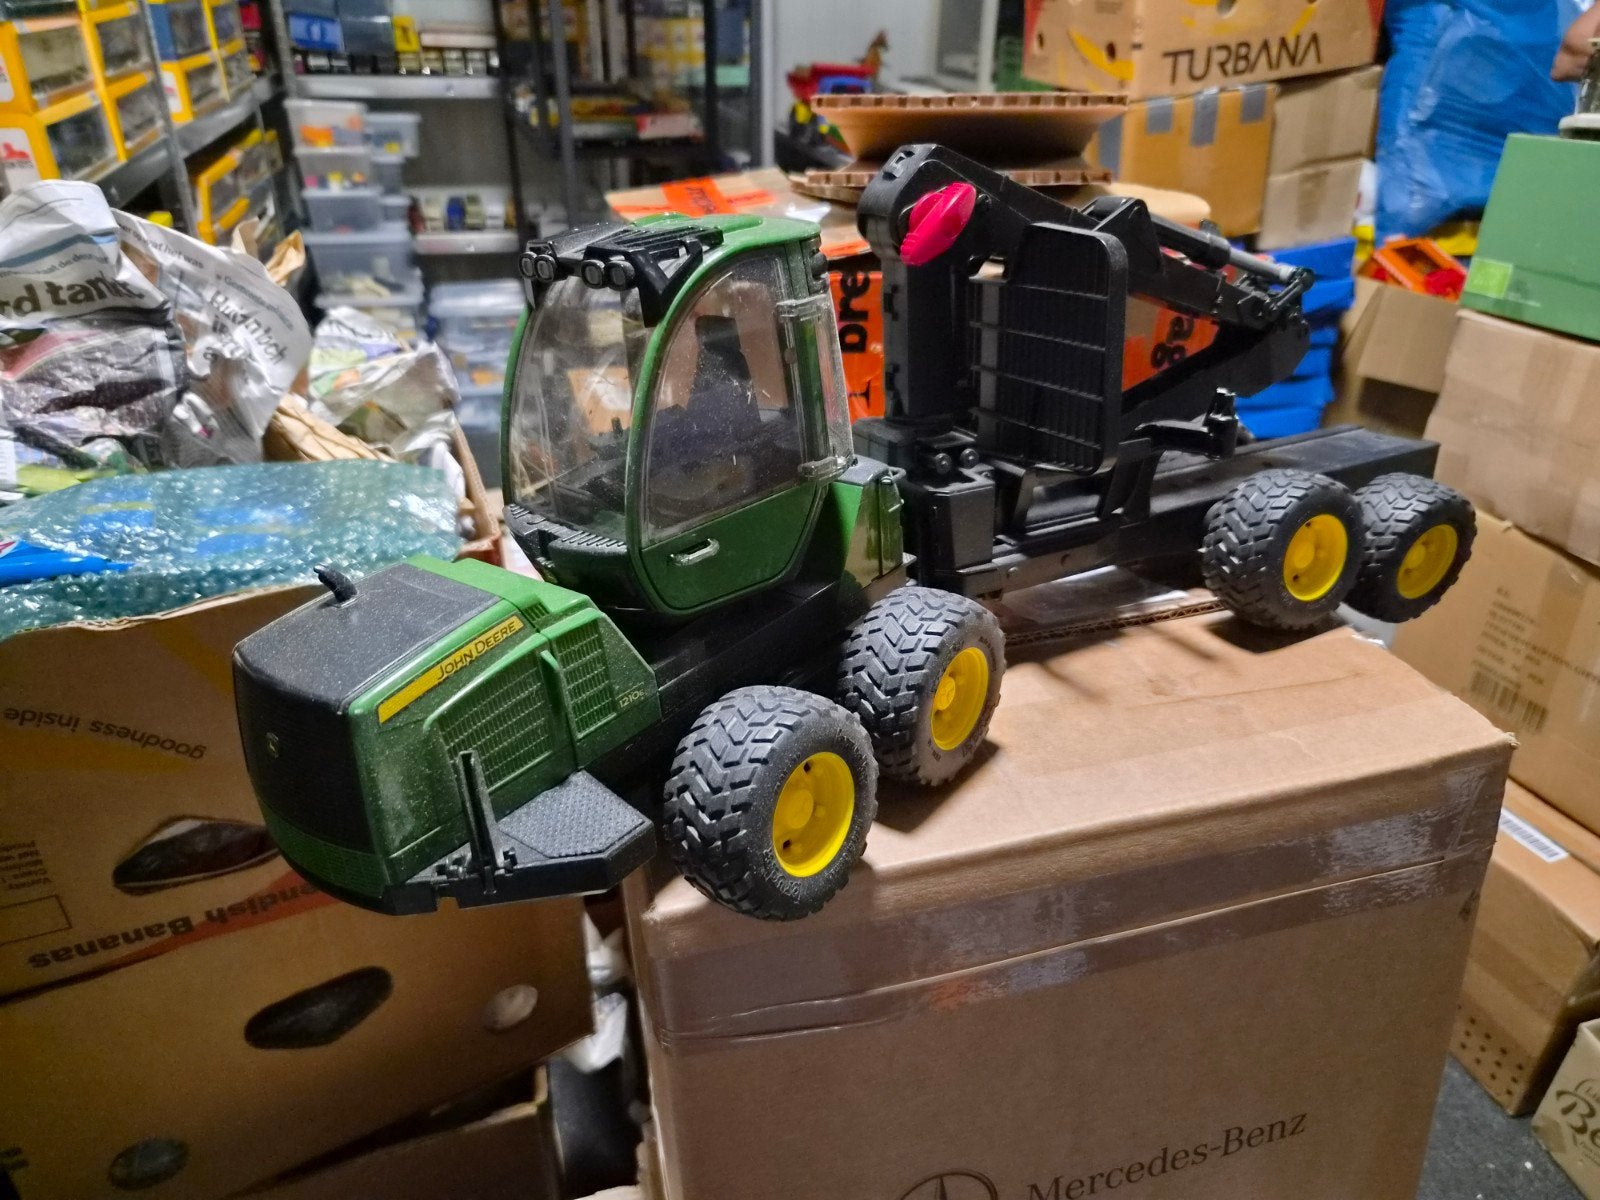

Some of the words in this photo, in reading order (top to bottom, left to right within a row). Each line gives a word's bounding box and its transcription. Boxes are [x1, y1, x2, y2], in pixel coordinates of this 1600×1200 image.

[1163, 31, 1322, 85] TURBANA
[437, 651, 474, 681] JOHN
[474, 620, 516, 656] DEERE
[3, 707, 80, 733] inside
[89, 719, 207, 760] goodness
[27, 915, 194, 969] Bananas
[1026, 1113, 1308, 1200] Mercedes-Benz
